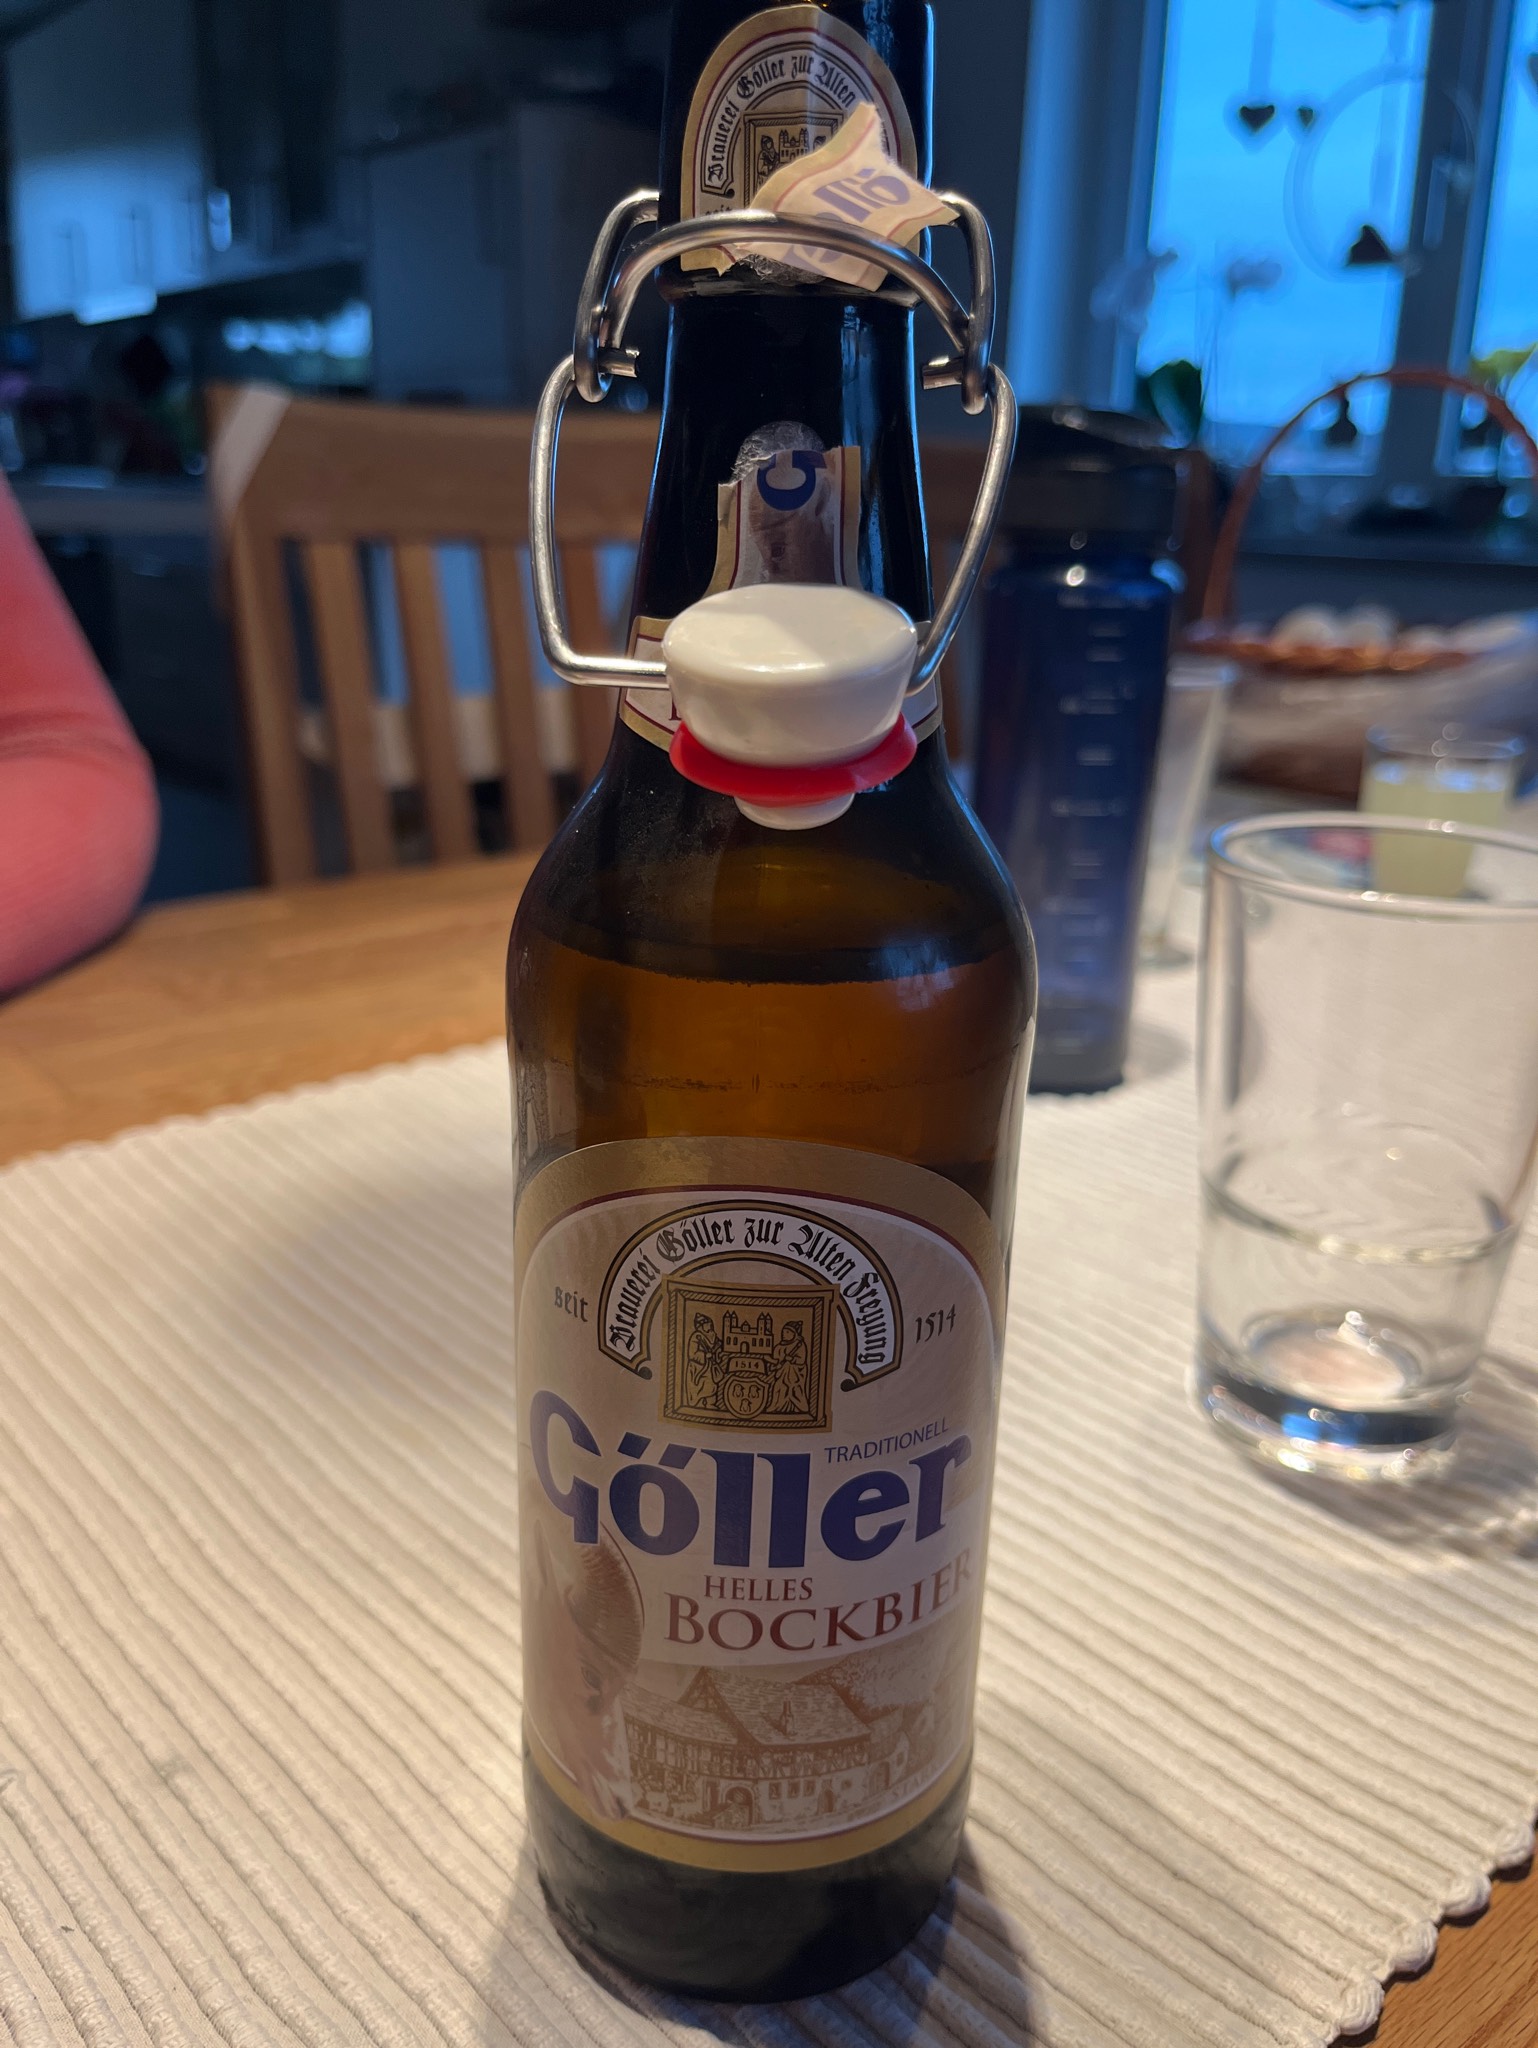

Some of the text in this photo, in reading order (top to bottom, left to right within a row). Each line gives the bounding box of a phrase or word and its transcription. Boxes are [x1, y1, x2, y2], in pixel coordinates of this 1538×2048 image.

[708, 53, 856, 182] Brauerei Göller zur Alten
[554, 1285, 589, 1323] seit
[609, 1216, 887, 1364] Brauerei Göller zur Alten Freyung
[915, 1303, 957, 1344] 1514
[735, 1360, 760, 1369] 1514
[825, 1418, 949, 1464] TRADITIONELL
[530, 1389, 972, 1568] Göller
[664, 1547, 972, 1651] BOCKBIER
[704, 1575, 813, 1601] HELLES
